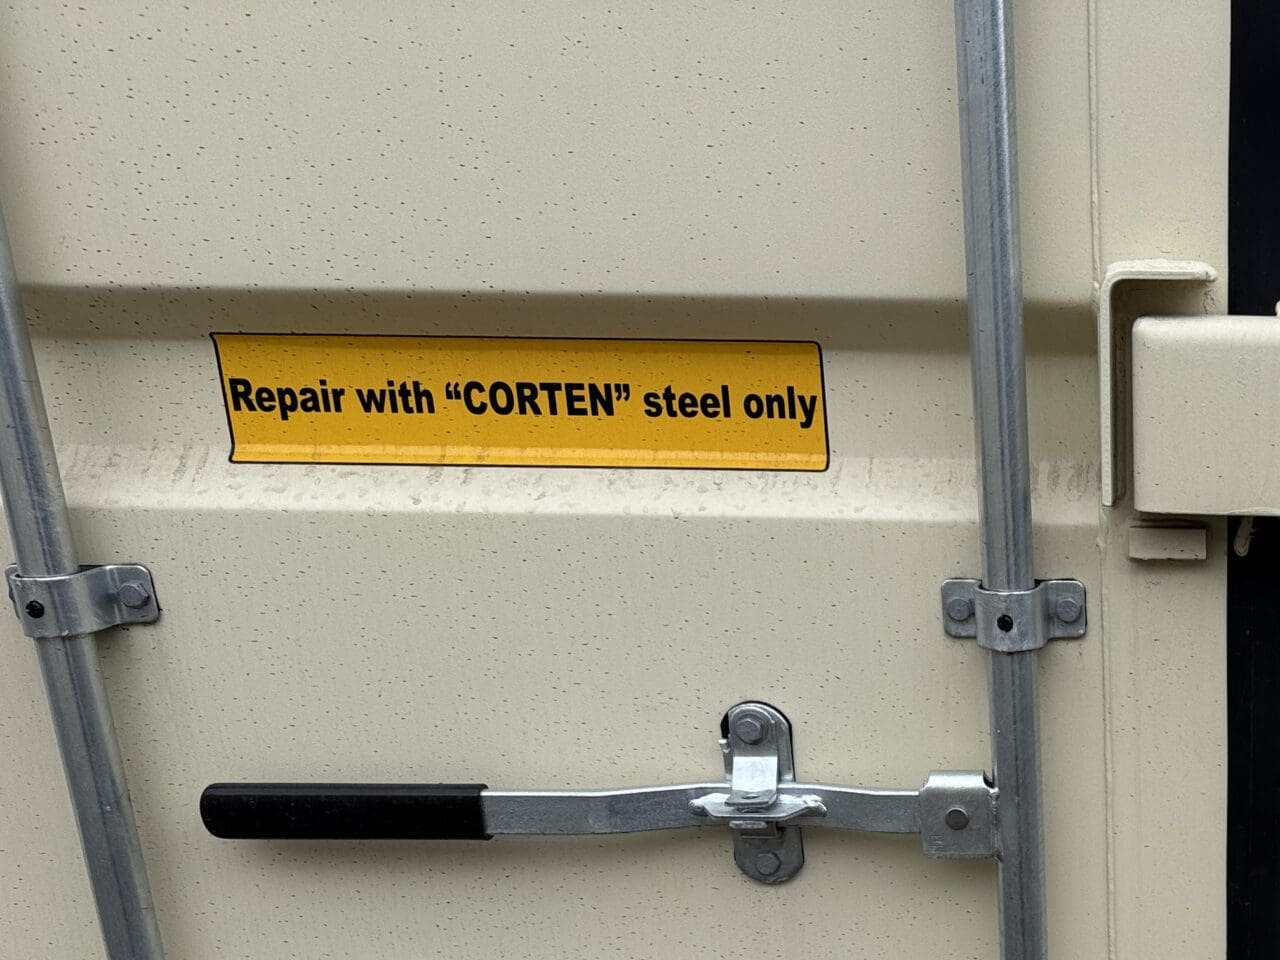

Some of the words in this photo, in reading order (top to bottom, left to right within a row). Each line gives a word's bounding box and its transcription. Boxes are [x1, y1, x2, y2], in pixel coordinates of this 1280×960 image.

[229, 377, 346, 421] Repair
[355, 380, 436, 415] with
[445, 380, 631, 417] “CORTEN”
[643, 384, 732, 419] steel
[743, 385, 818, 429] only
